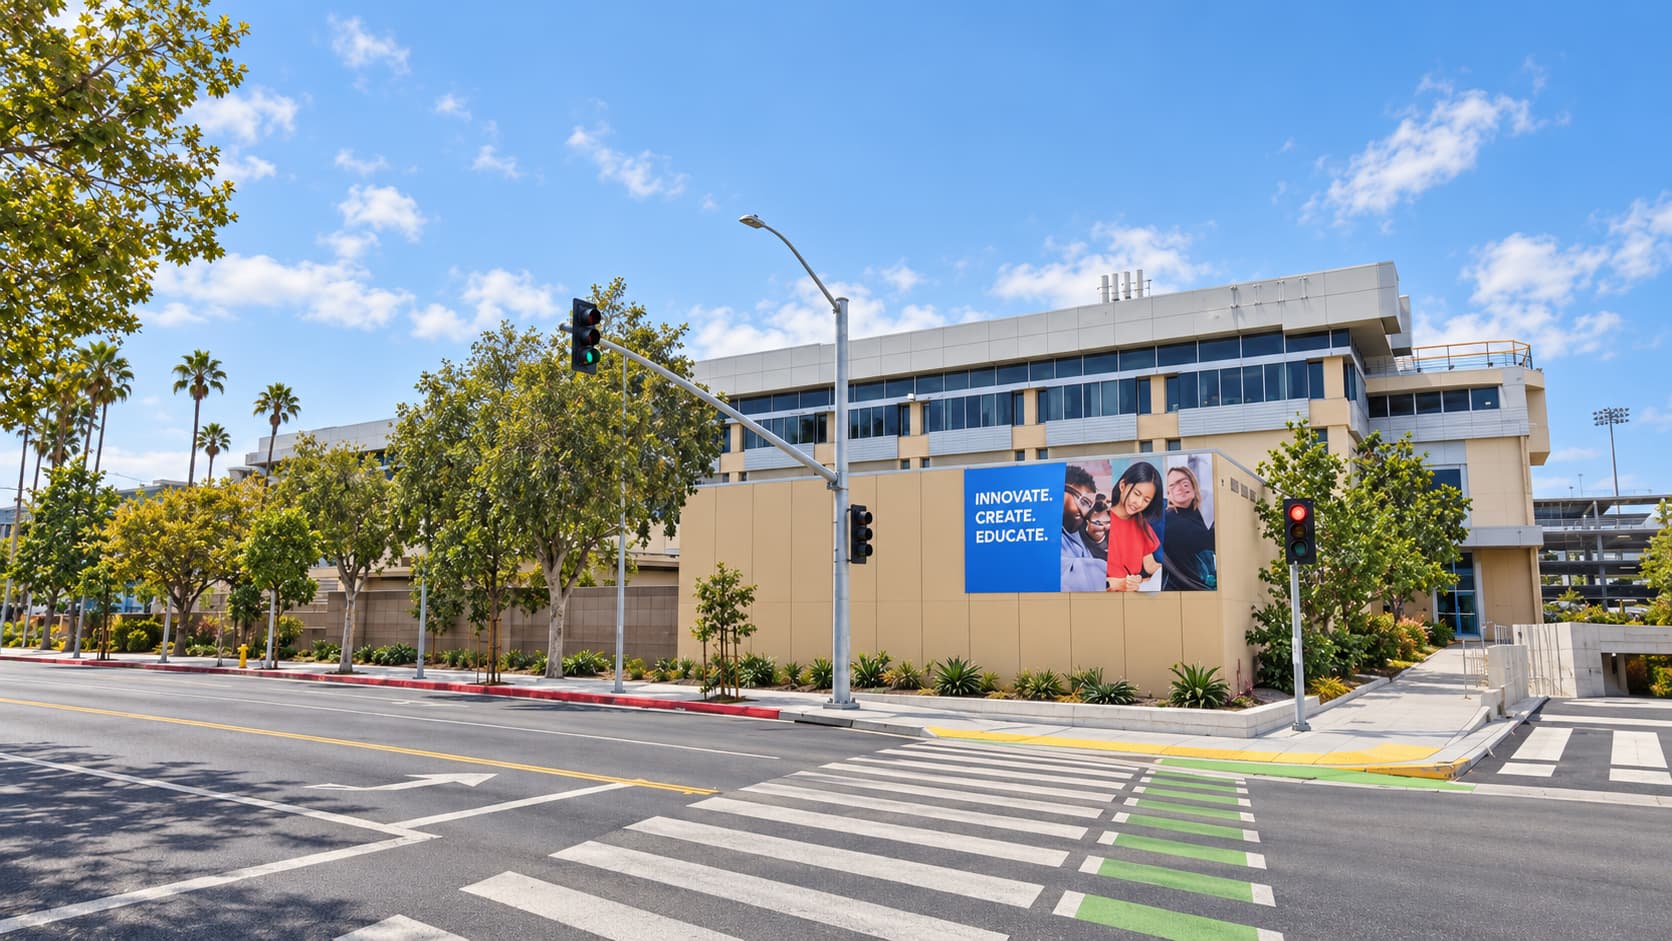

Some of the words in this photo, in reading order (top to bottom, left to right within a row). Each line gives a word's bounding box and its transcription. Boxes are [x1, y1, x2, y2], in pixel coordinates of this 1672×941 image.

[975, 488, 1053, 505] INNOVATE.
[975, 508, 1036, 524] CREATE.
[975, 527, 1049, 544] EDUCATE.
